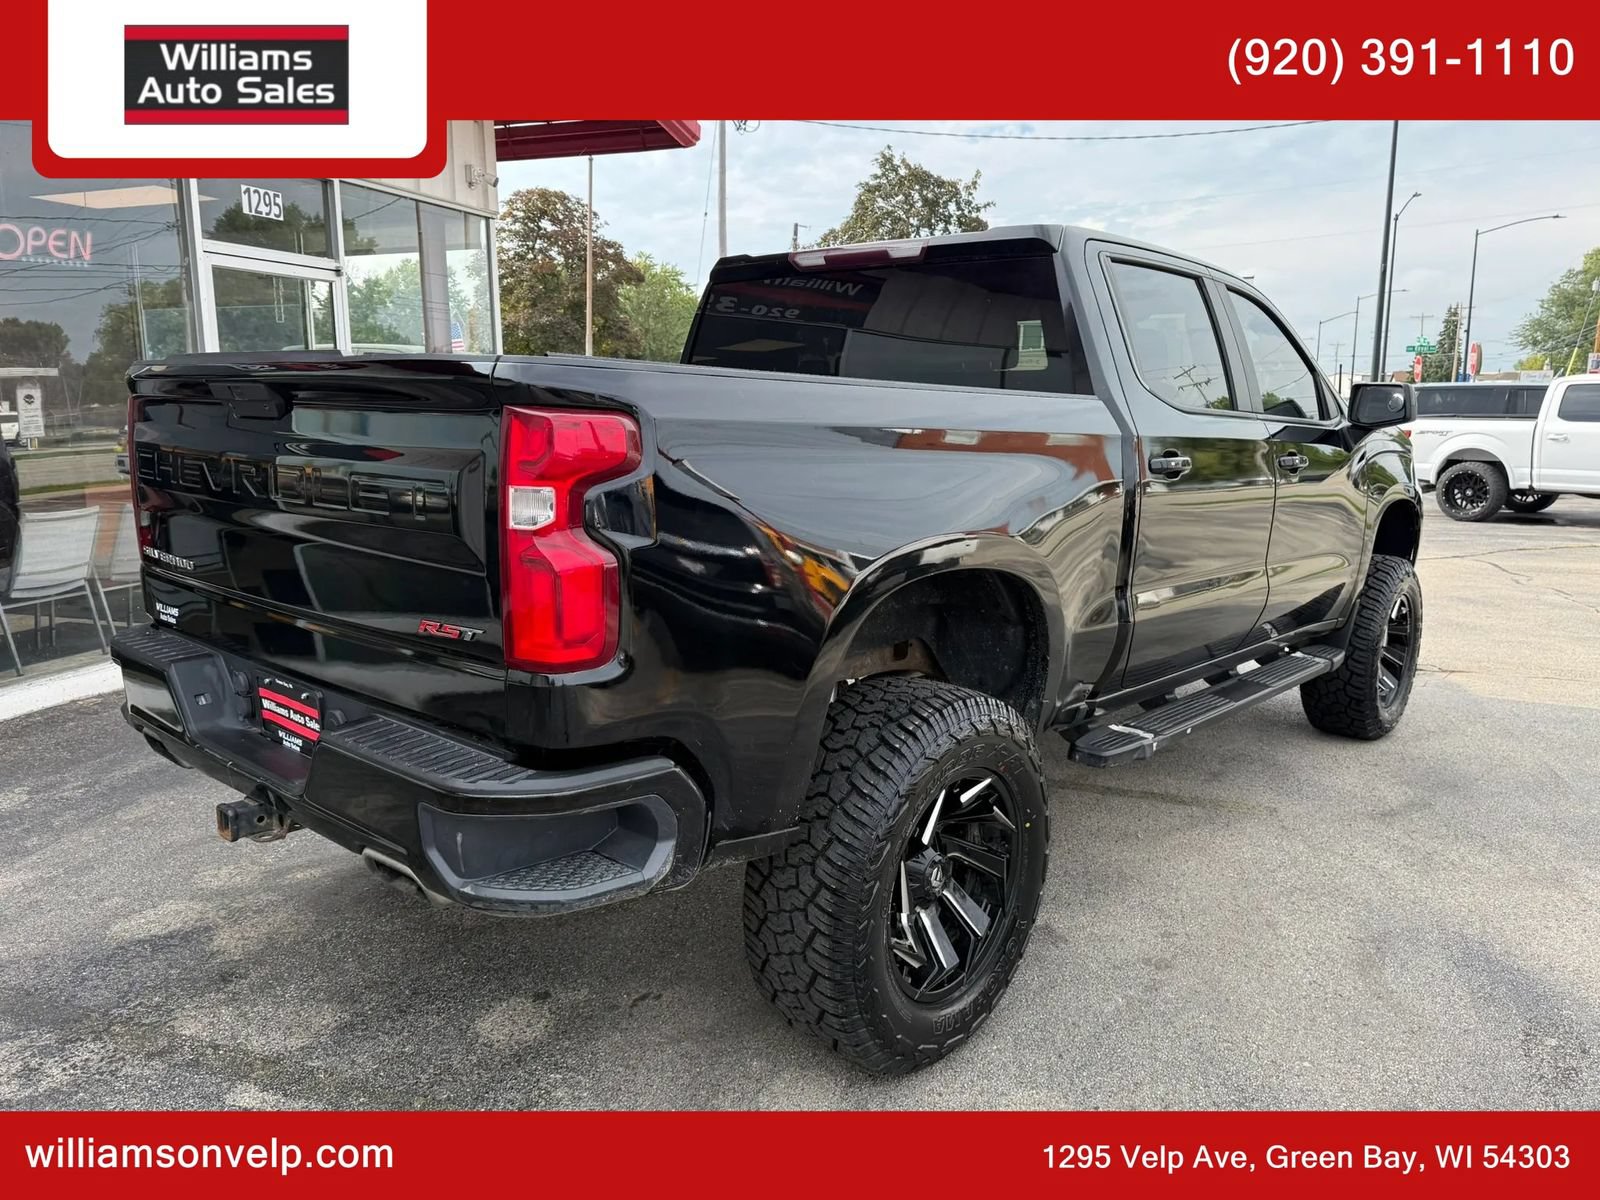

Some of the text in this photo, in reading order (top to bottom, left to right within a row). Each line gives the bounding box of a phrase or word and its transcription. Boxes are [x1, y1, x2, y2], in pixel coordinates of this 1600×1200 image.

[243, 187, 282, 218] 1295
[0, 223, 93, 262] OPEN
[136, 450, 452, 521] CHEVROLET
[416, 618, 486, 641] RST
[261, 698, 289, 718] Williams
[290, 709, 305, 725] Auto
